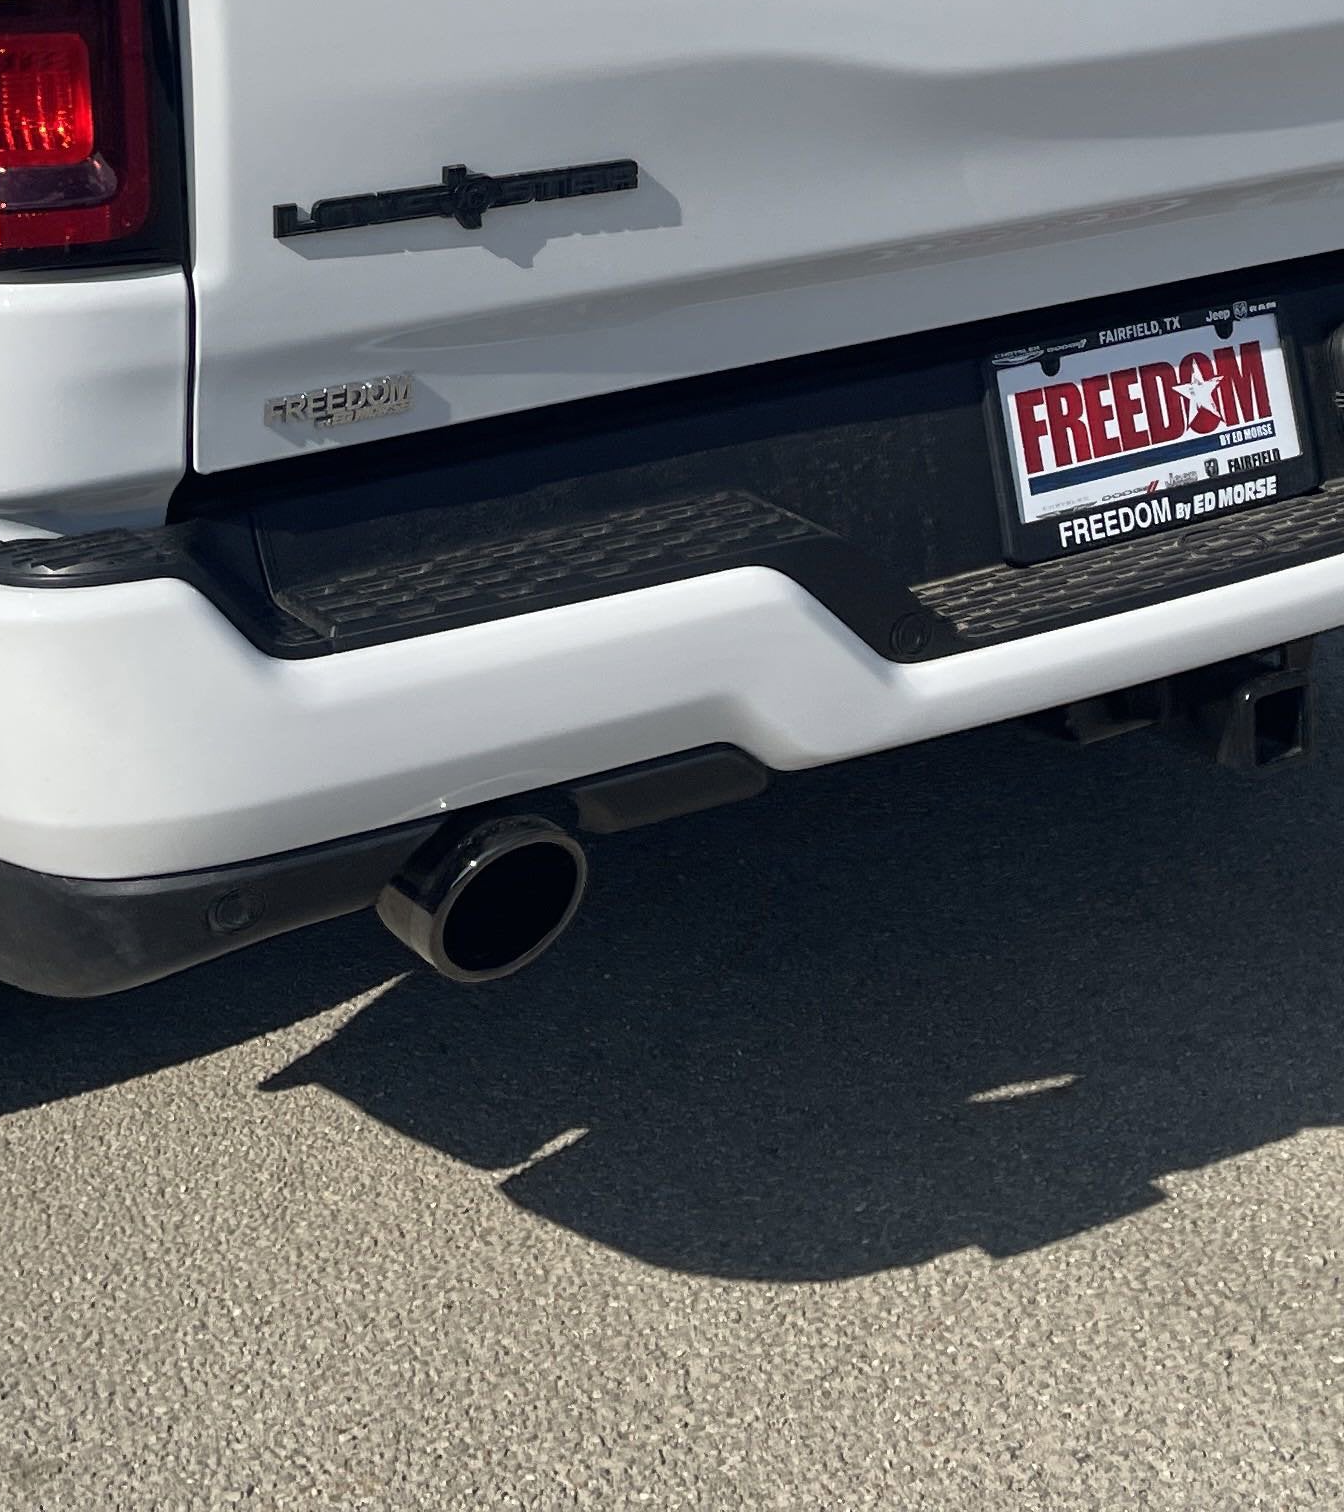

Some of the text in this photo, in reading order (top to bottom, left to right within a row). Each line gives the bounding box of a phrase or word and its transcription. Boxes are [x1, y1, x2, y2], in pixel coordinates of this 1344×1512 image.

[1098, 321, 1163, 345] FAIRFIELD,
[1164, 315, 1181, 331] TX
[1205, 308, 1231, 323] Jeep
[264, 374, 414, 426] FREEDOM
[1014, 341, 1273, 475] FREEDOM
[1219, 423, 1273, 447] BY ED MORSE
[1058, 497, 1172, 549] FREEDOM
[1193, 491, 1216, 515] ED
[1218, 476, 1277, 509] MORSE
